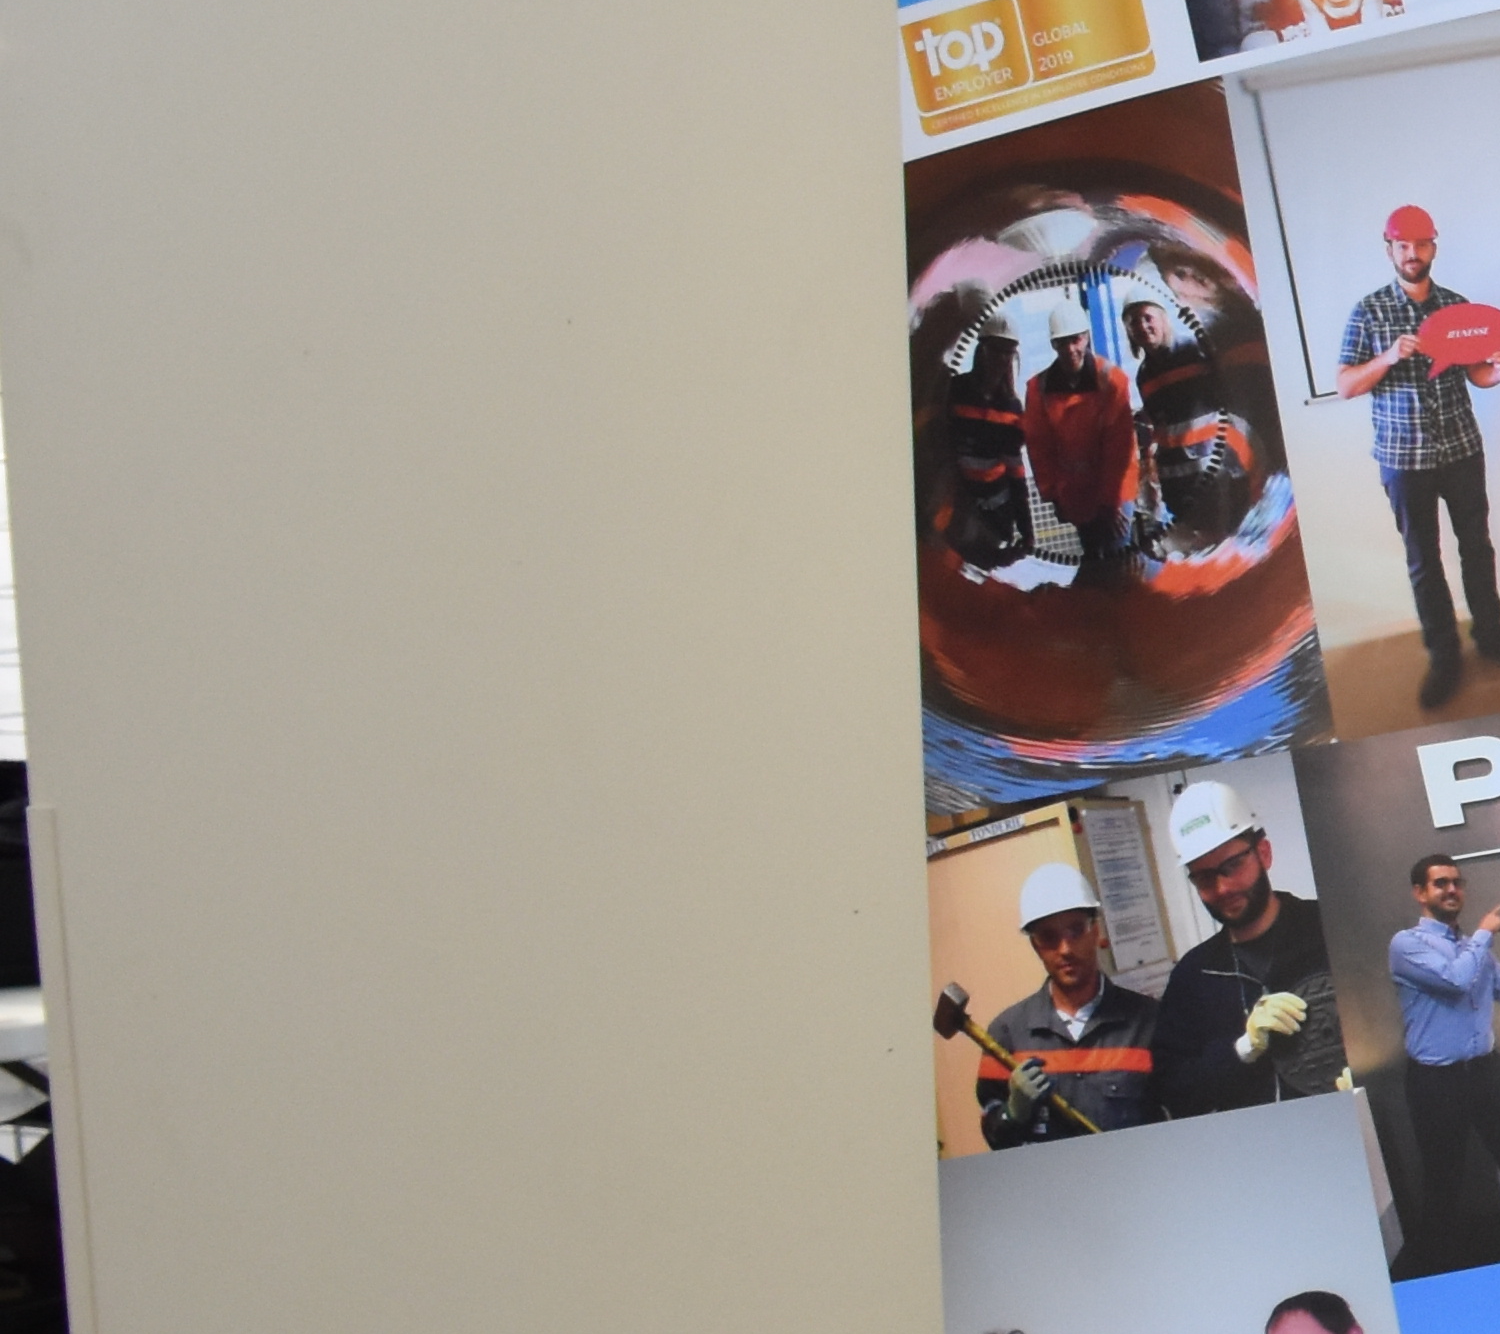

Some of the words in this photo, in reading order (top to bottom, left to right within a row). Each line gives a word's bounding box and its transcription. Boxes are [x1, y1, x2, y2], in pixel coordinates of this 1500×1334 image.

[914, 20, 1005, 77] top
[1032, 20, 1091, 47] GLOBAL
[1037, 50, 1074, 73] 2019
[934, 66, 1013, 102] EMPLOYER
